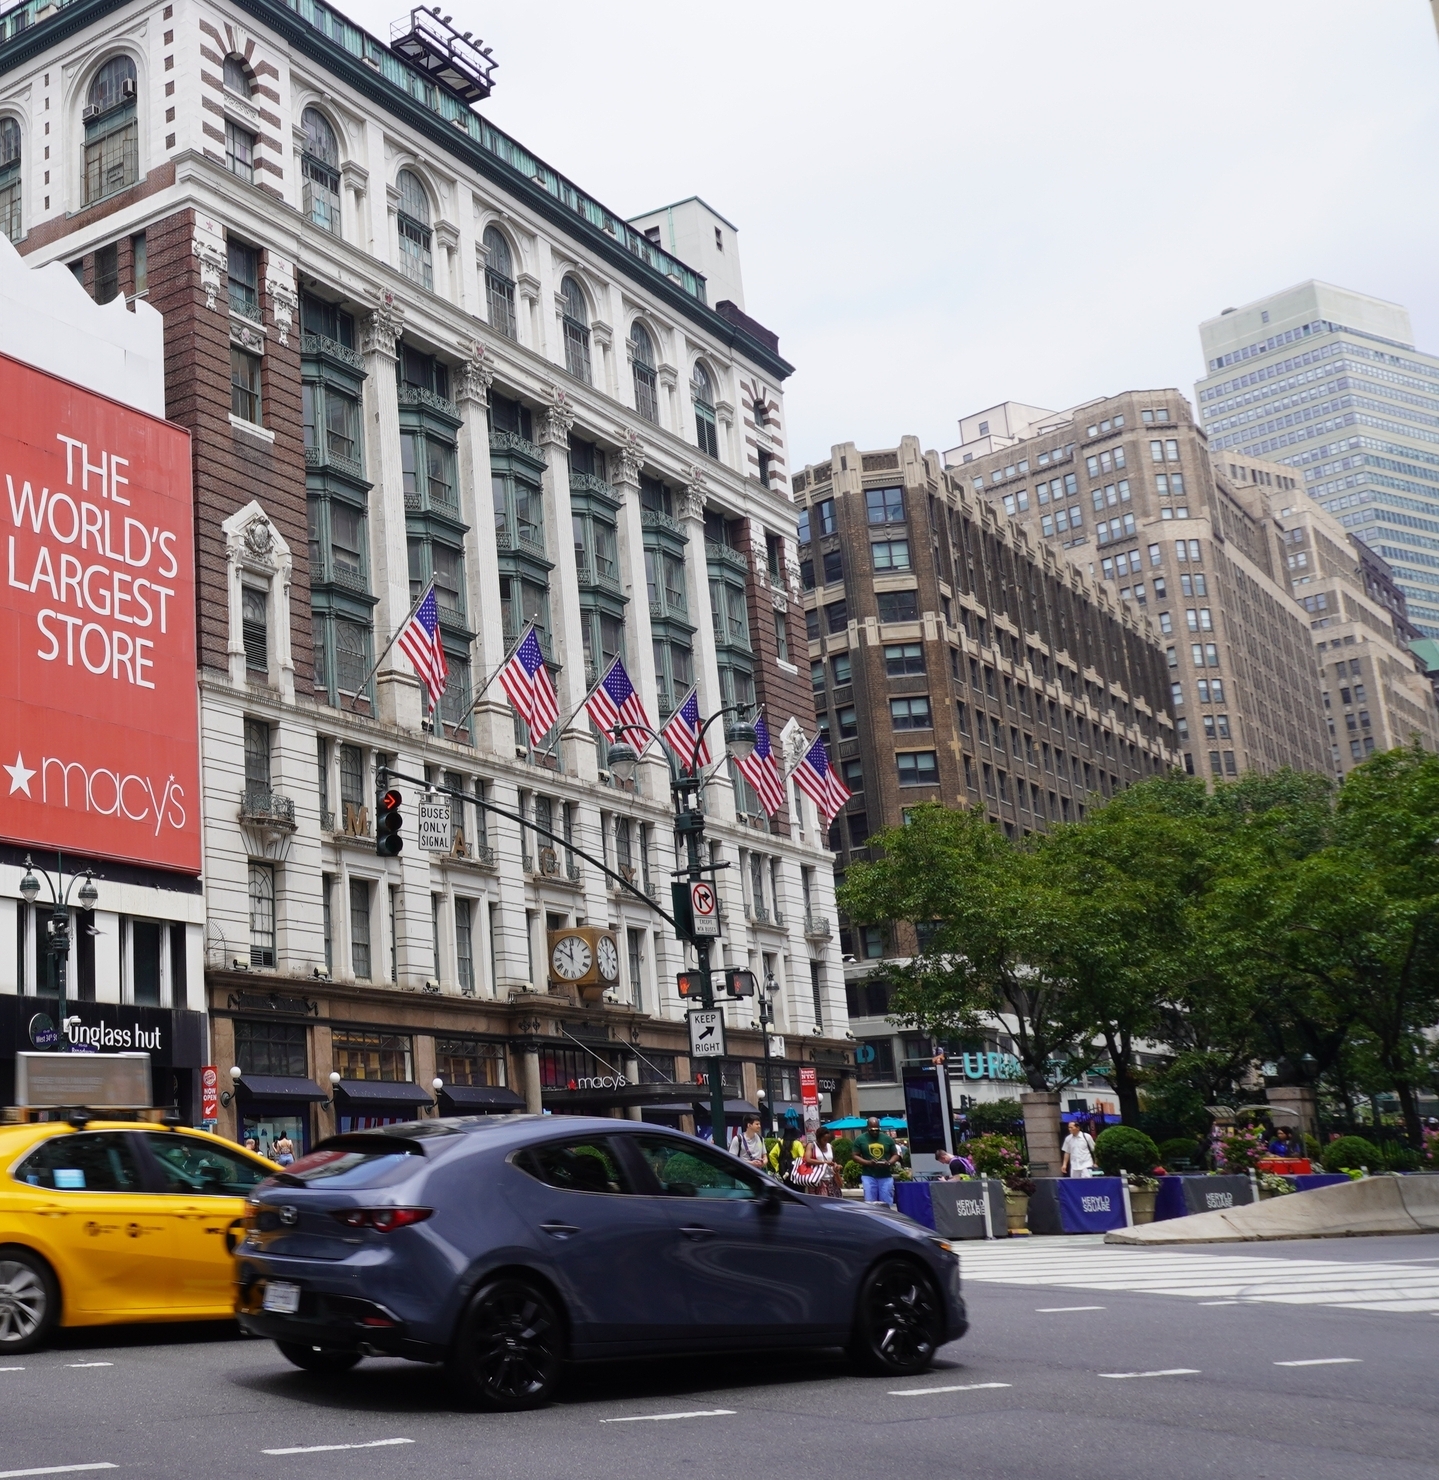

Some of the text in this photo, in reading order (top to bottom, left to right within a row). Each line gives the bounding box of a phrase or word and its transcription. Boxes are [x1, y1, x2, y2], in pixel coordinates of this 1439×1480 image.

[56, 433, 130, 507] THE
[5, 474, 178, 579] WORLD'S
[8, 536, 174, 634] LARGEST
[37, 608, 155, 689] STORE
[42, 756, 187, 837] macy's
[421, 807, 450, 820] BUSES
[424, 822, 447, 834] ONLY
[421, 835, 449, 848] SIGNAL
[694, 1014, 716, 1024] KEEP
[36, 1034, 46, 1043] West
[68, 1020, 162, 1051] unglass hut
[696, 1043, 720, 1052] RIGHT
[578, 1072, 626, 1091] macy's
[1082, 1204, 1111, 1212] SQUARE
[1207, 1200, 1234, 1208] SQUARE
[958, 1208, 986, 1216] SQUARE
